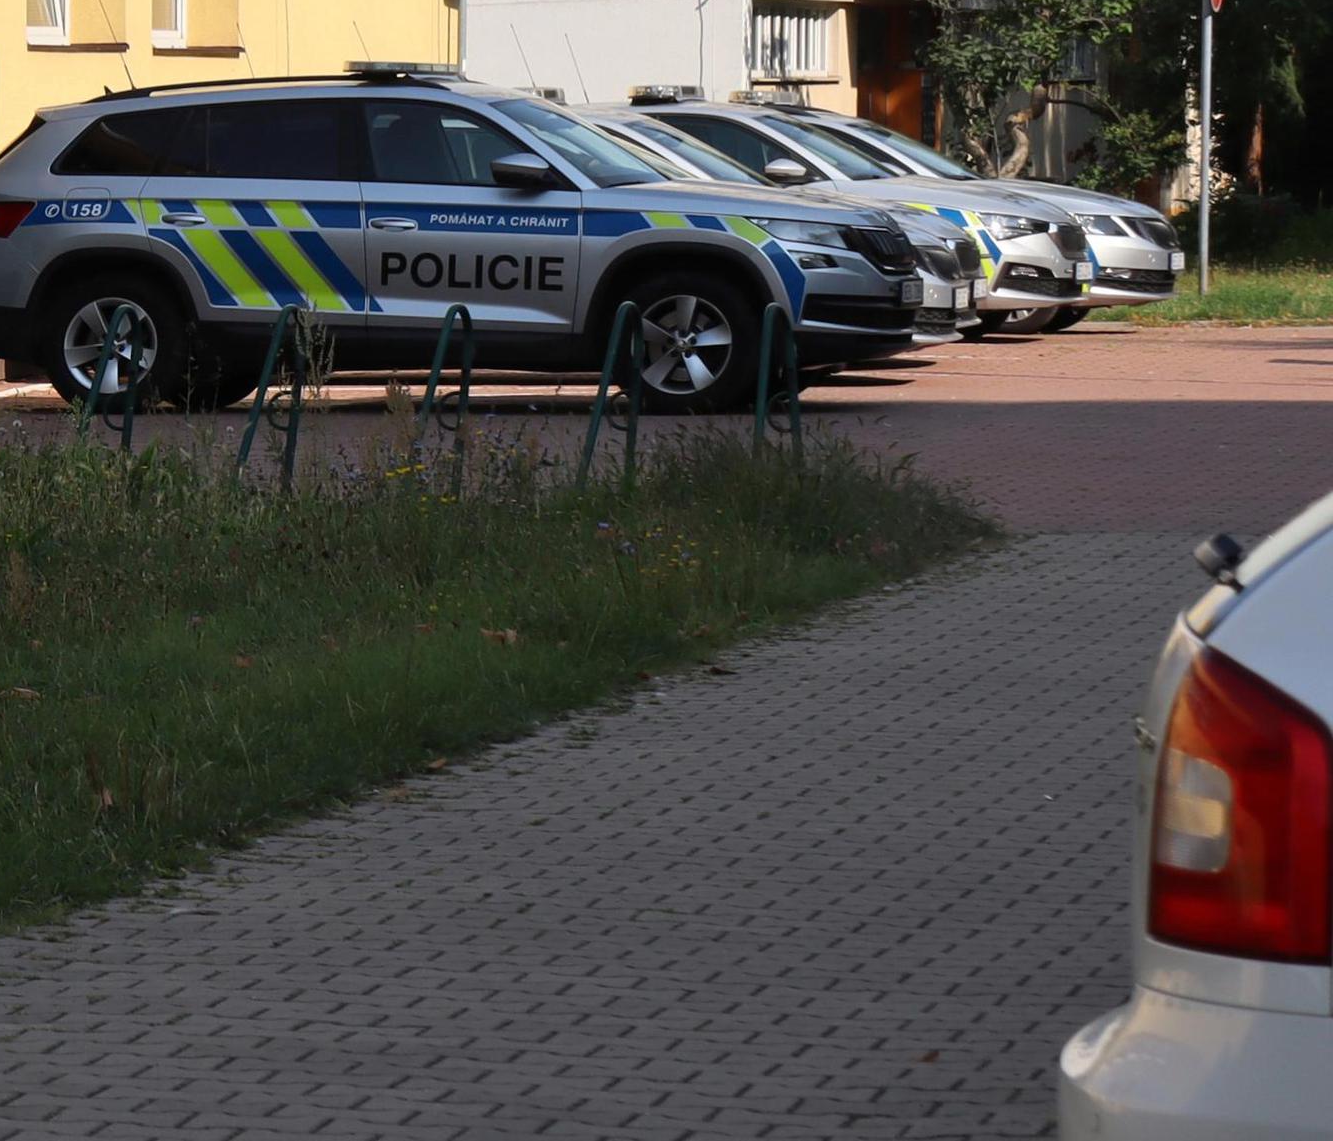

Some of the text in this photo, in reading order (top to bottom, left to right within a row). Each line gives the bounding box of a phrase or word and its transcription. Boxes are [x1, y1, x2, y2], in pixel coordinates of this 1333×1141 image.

[71, 203, 102, 217] 158
[429, 212, 570, 228] POMÁHAT A CHRÁNIT
[381, 251, 565, 292] POLICIE
